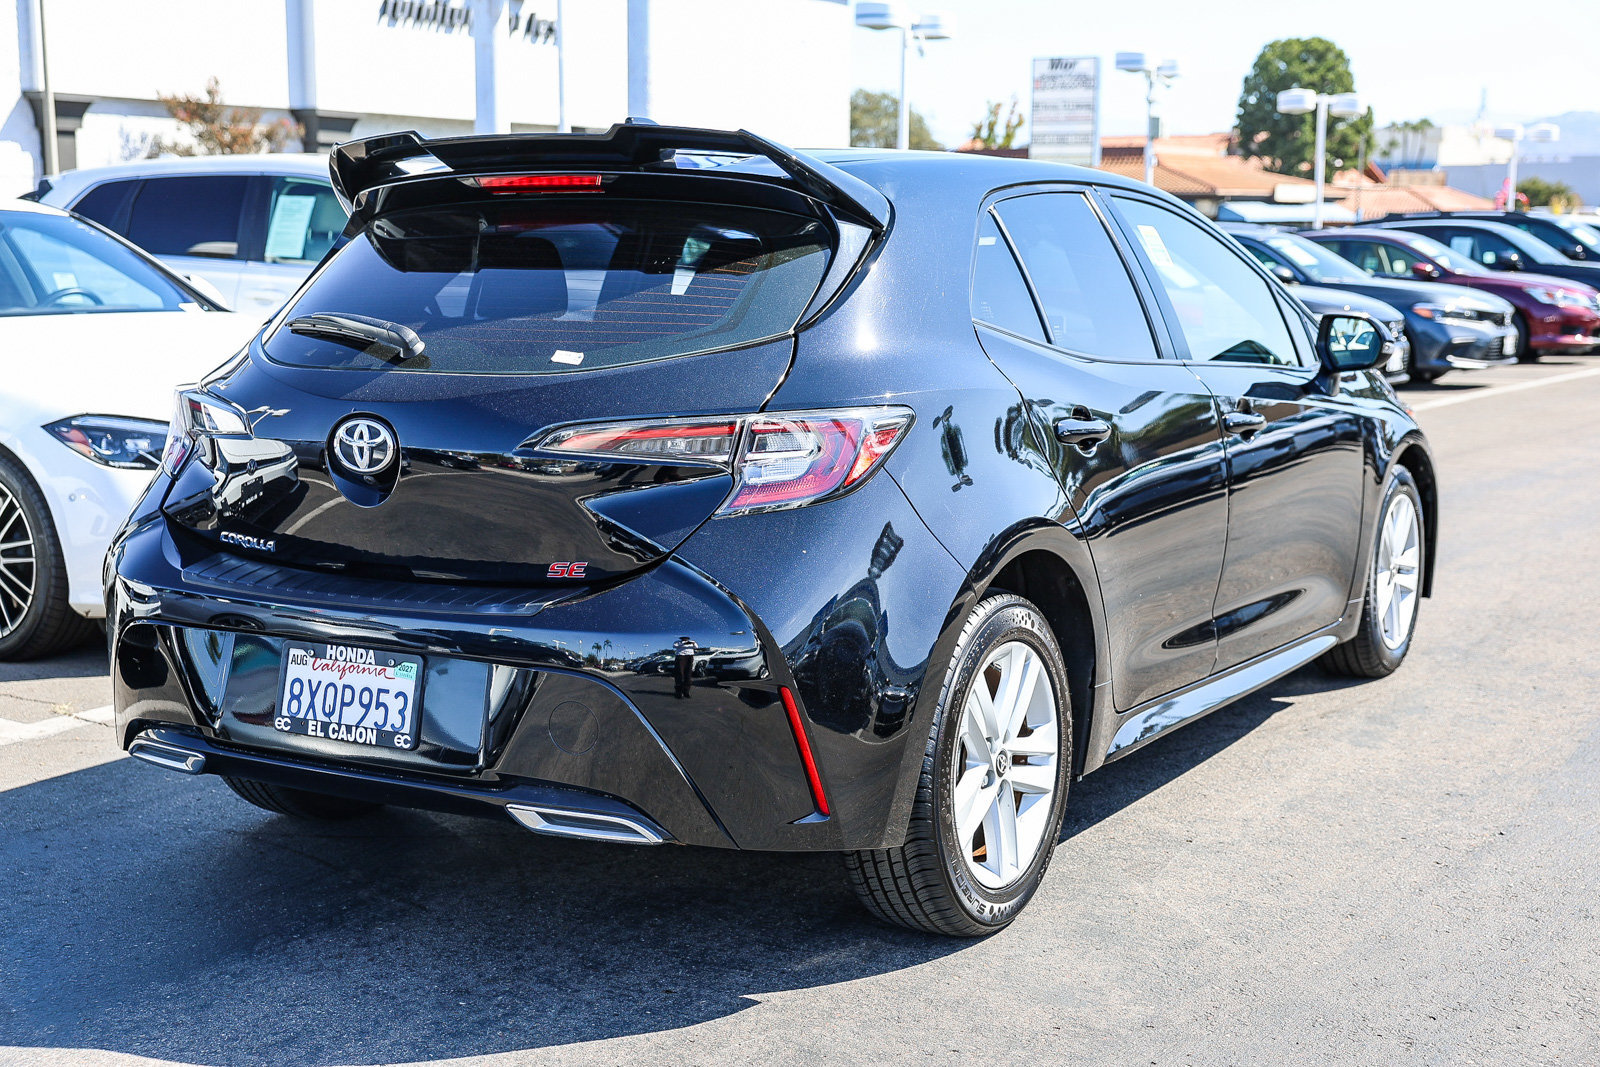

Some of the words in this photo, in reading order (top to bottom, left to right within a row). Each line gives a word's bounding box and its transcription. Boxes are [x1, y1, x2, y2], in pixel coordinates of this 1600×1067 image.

[220, 531, 276, 552] COROLLA
[546, 561, 589, 579] SE
[290, 653, 308, 666] AUG
[326, 644, 376, 665] HONDA
[312, 657, 396, 681] California
[398, 664, 413, 673] 2027
[287, 677, 409, 732] 8XQP953
[307, 719, 325, 738] EL
[328, 723, 377, 745] CAJON
